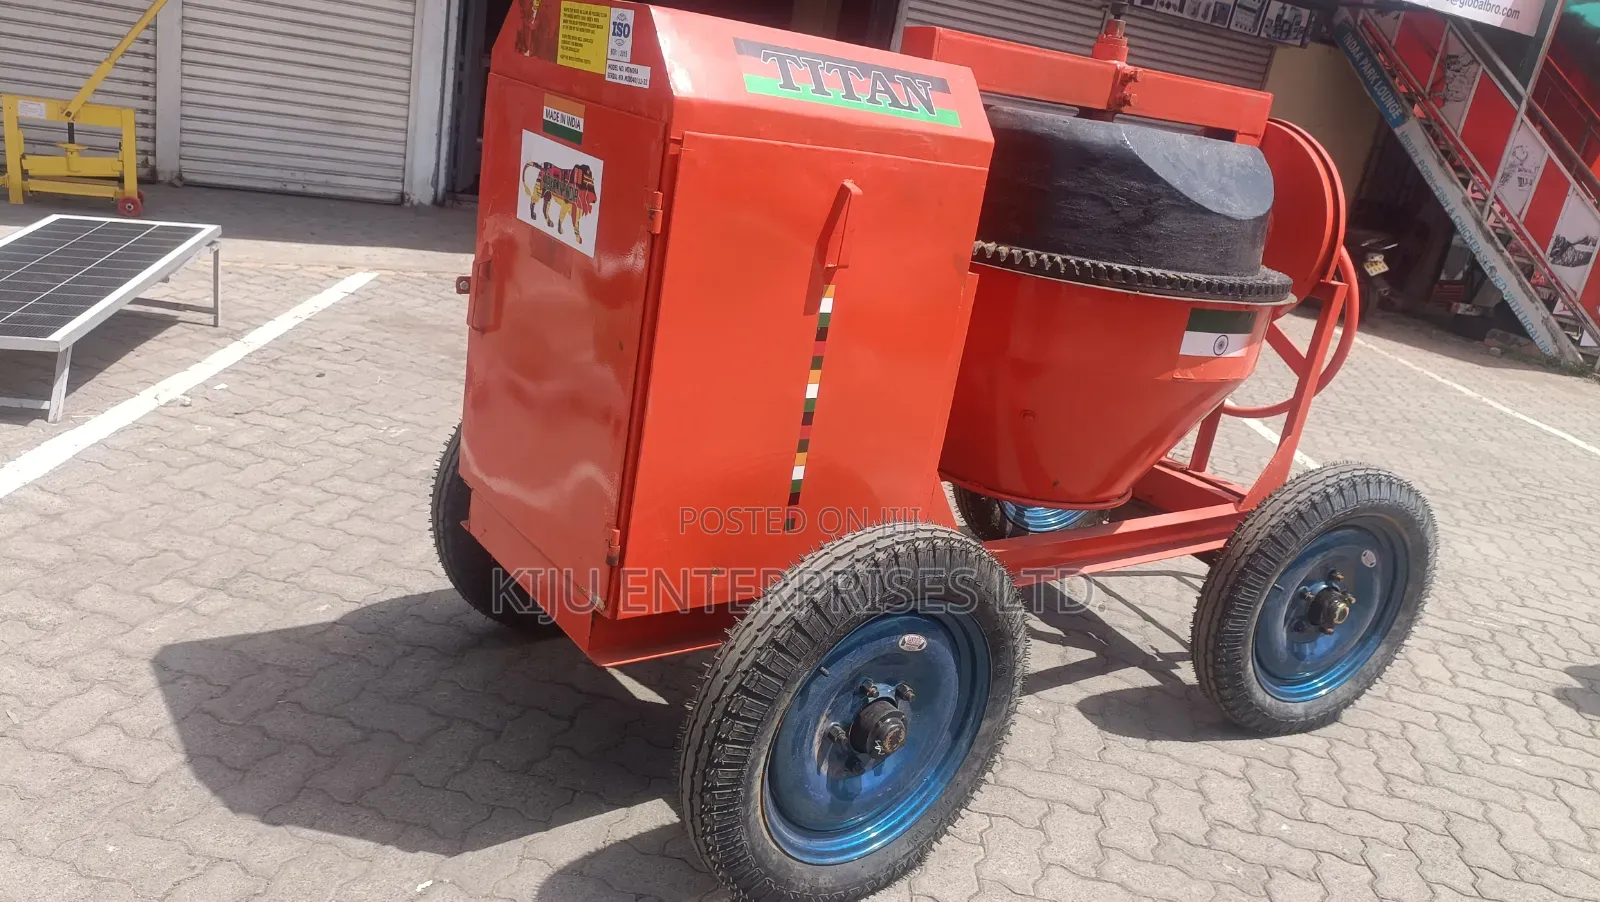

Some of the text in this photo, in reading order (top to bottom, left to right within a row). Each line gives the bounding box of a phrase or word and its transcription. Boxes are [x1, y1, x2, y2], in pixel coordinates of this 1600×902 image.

[1445, 0, 1520, 20] gobalbro.com
[612, 21, 631, 38] ISO
[607, 63, 619, 72] MODEL
[607, 72, 618, 80] SERIAL
[1343, 32, 1402, 120] INDAA PARK LOUNGE
[761, 50, 938, 117] TITAN
[545, 108, 581, 130] MADE IN INDIA
[1436, 186, 1452, 210] FISH
[1447, 207, 1456, 217] &
[1453, 215, 1484, 257] CHICKEN
[1503, 290, 1525, 317] WITH
